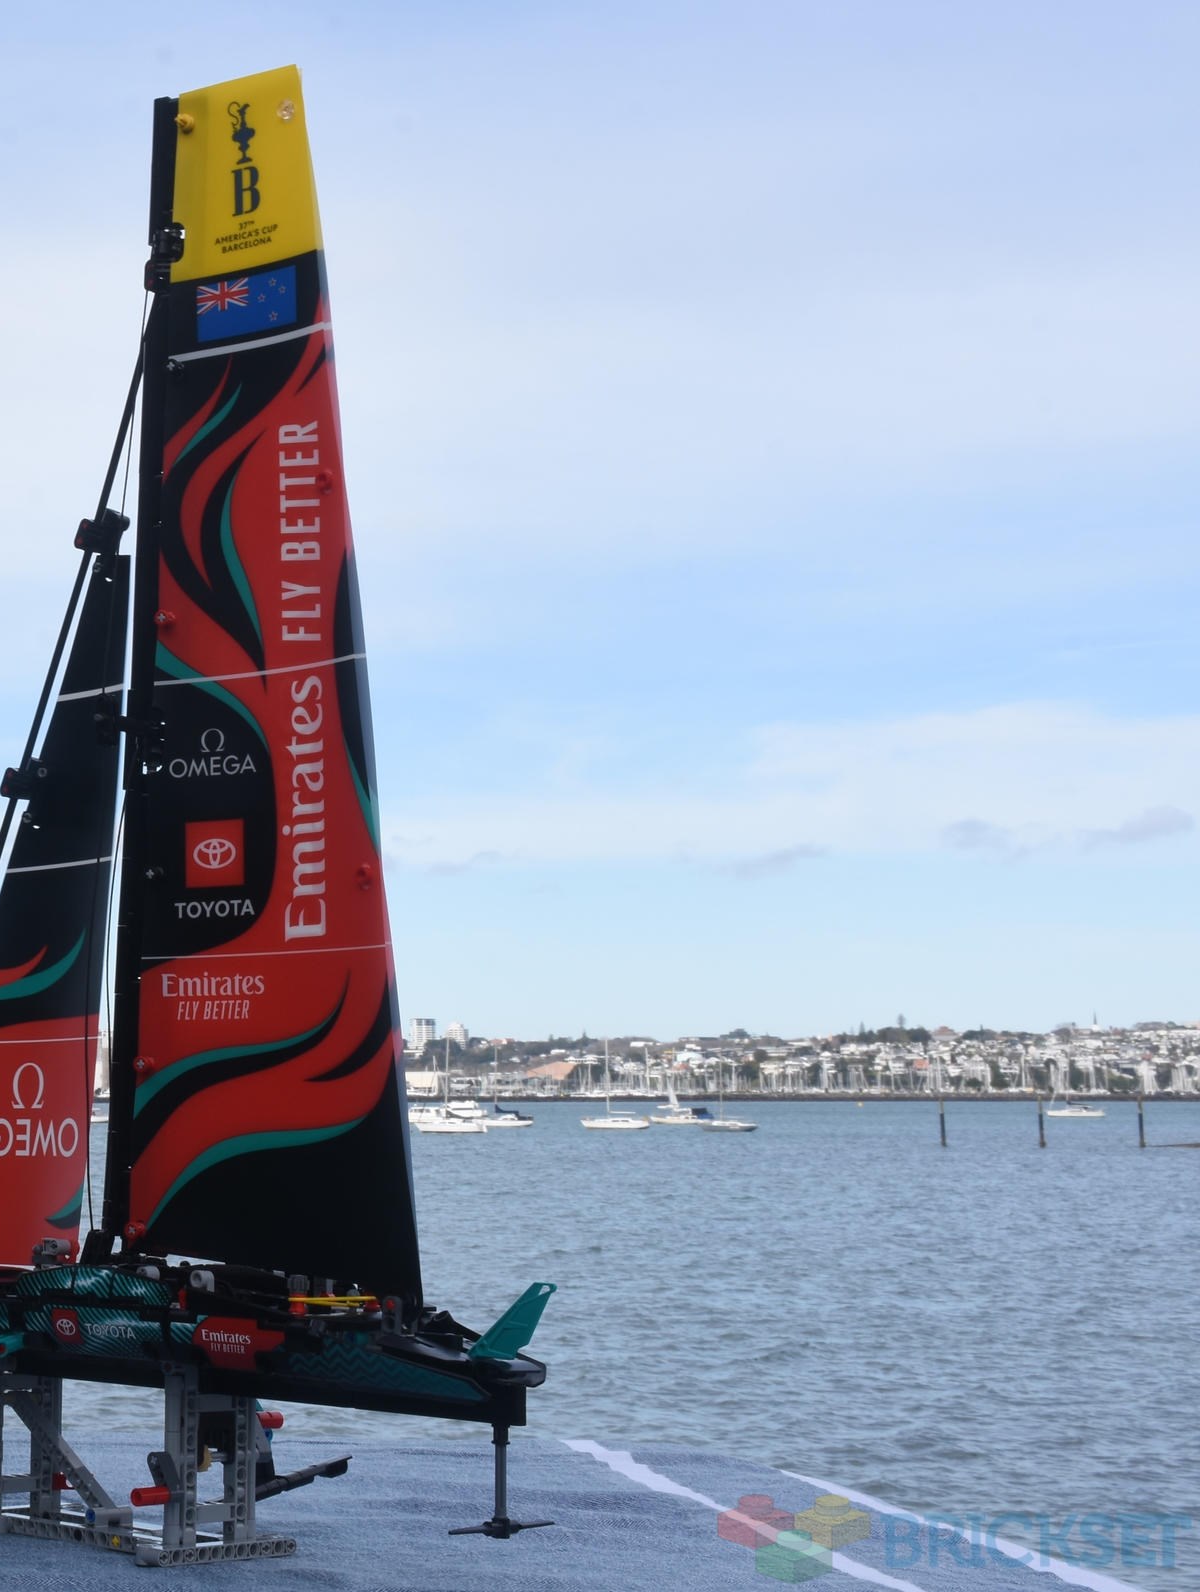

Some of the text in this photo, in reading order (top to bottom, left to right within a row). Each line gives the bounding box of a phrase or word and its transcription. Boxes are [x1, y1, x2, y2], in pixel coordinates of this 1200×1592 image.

[231, 165, 261, 217] B
[214, 223, 279, 246] AMERICA'S CUP
[221, 236, 273, 254] BARCELONA
[278, 420, 322, 642] FLY BETTER
[168, 754, 257, 779] OMEGA
[281, 674, 327, 943] Emirates
[174, 898, 256, 919] TOYOTA
[161, 971, 266, 998] Emirates
[177, 999, 251, 1021] FLY BETTER
[84, 1322, 137, 1340] TOYOTA
[201, 1328, 252, 1345] Emirates
[211, 1342, 246, 1354] FLY BETTER
